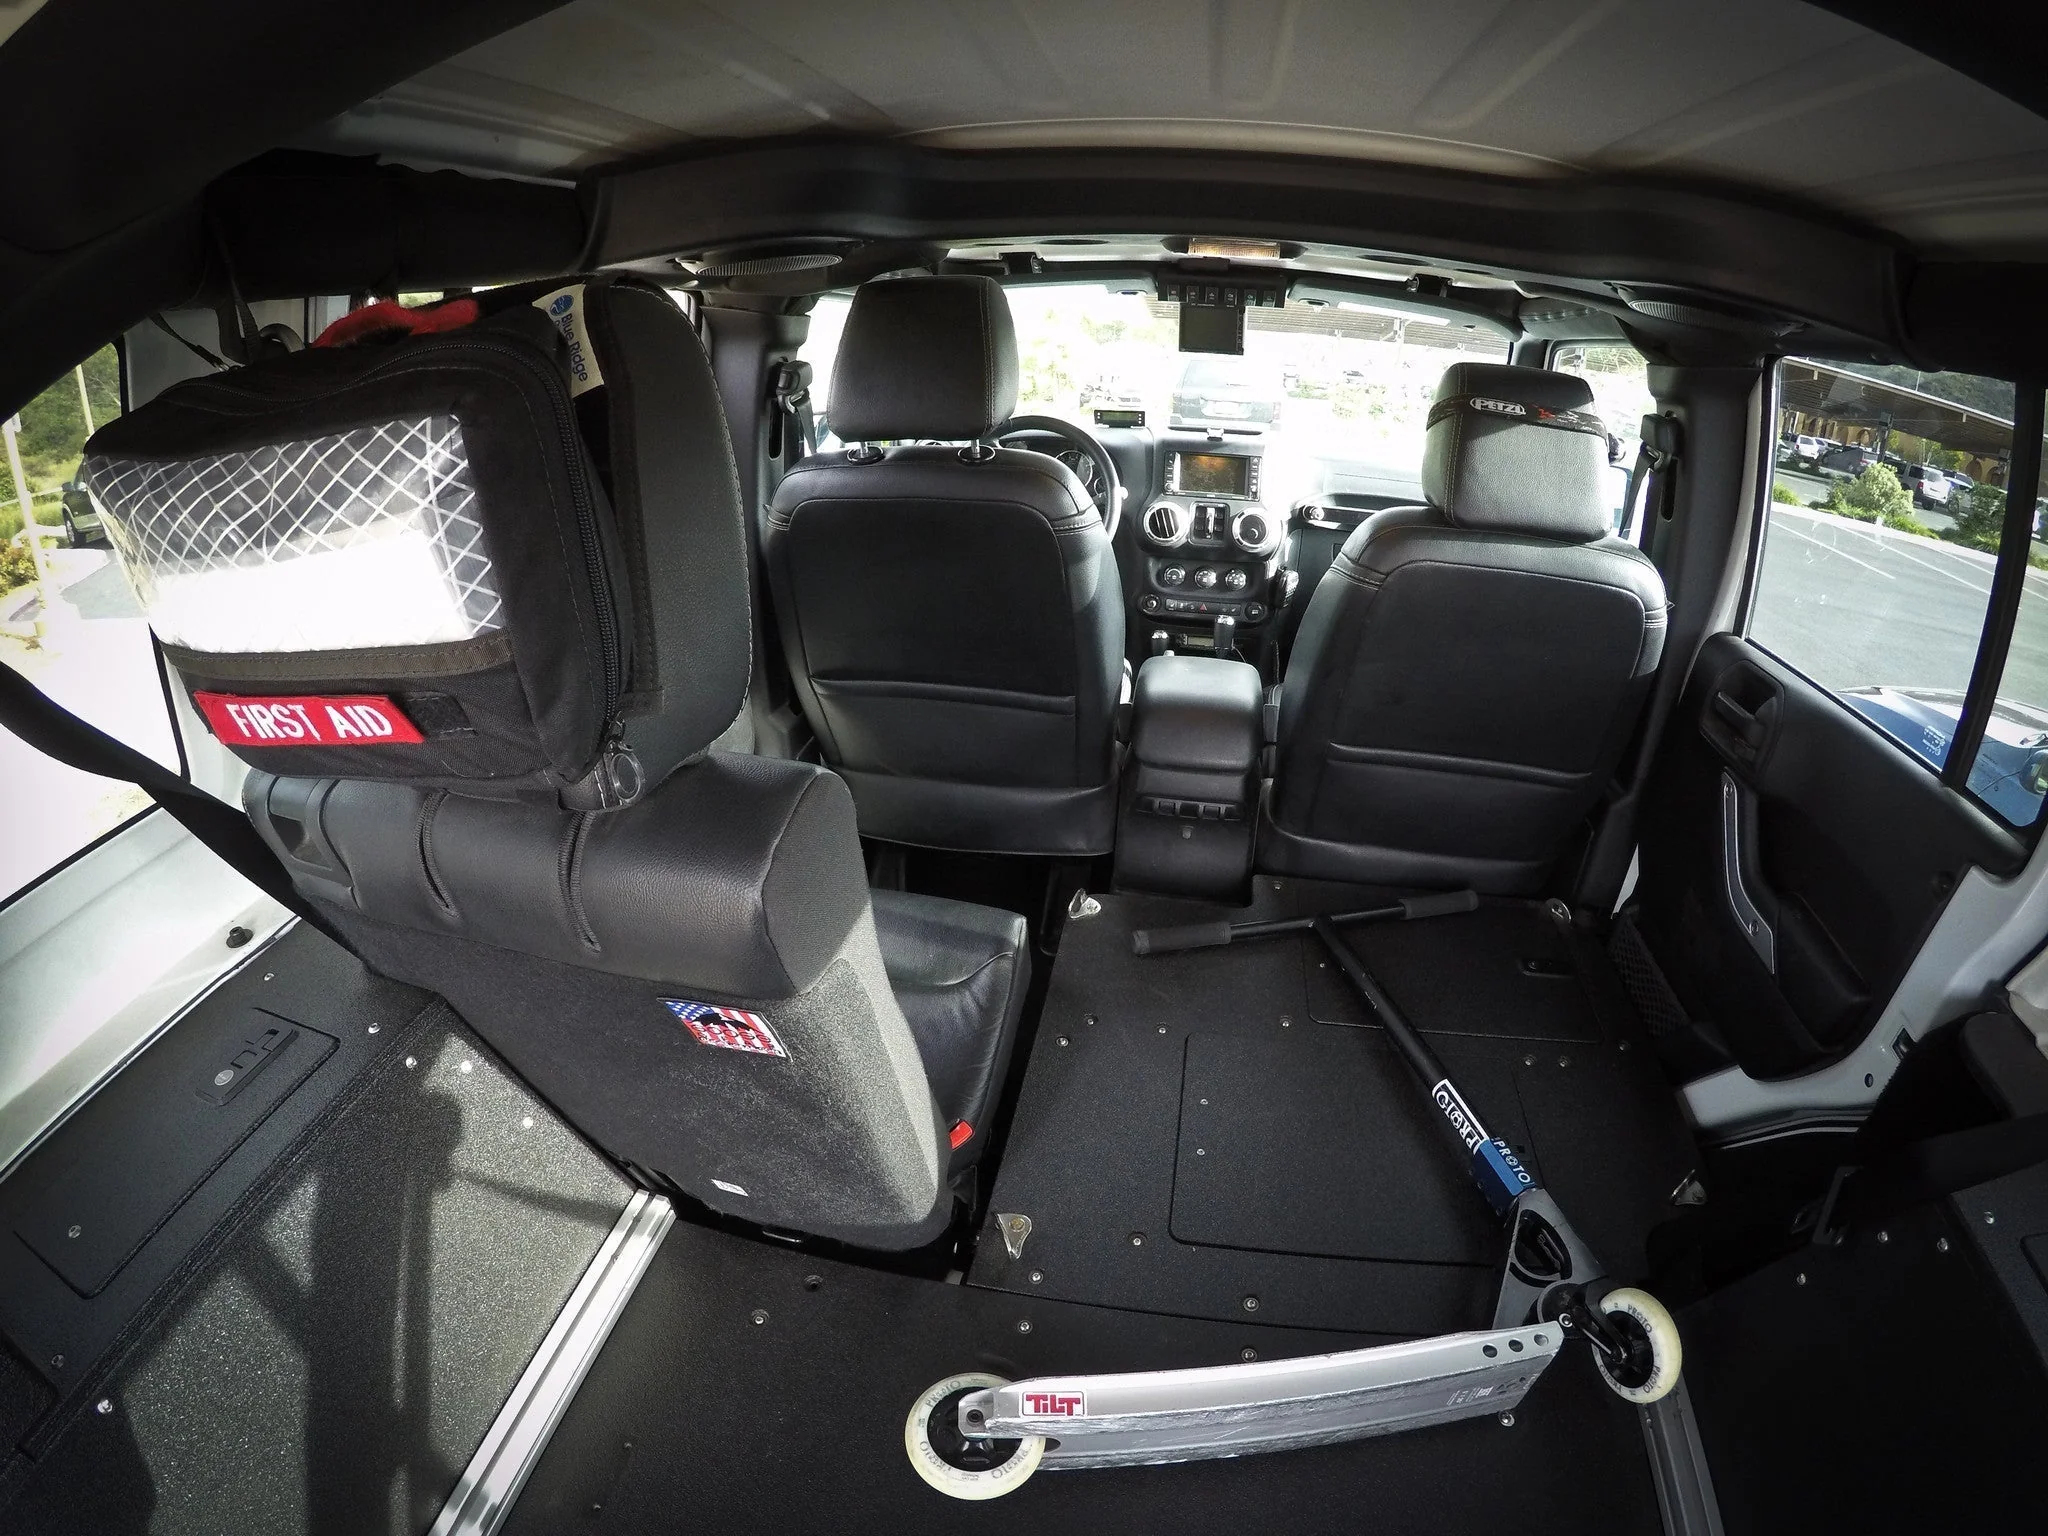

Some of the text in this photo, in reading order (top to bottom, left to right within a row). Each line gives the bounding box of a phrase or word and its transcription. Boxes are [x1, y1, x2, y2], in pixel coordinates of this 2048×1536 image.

[561, 313, 588, 382] Blue Ridge
[225, 703, 394, 742] FIRST AID
[1436, 1090, 1481, 1150] PROTO
[1493, 1140, 1531, 1184] PROTO
